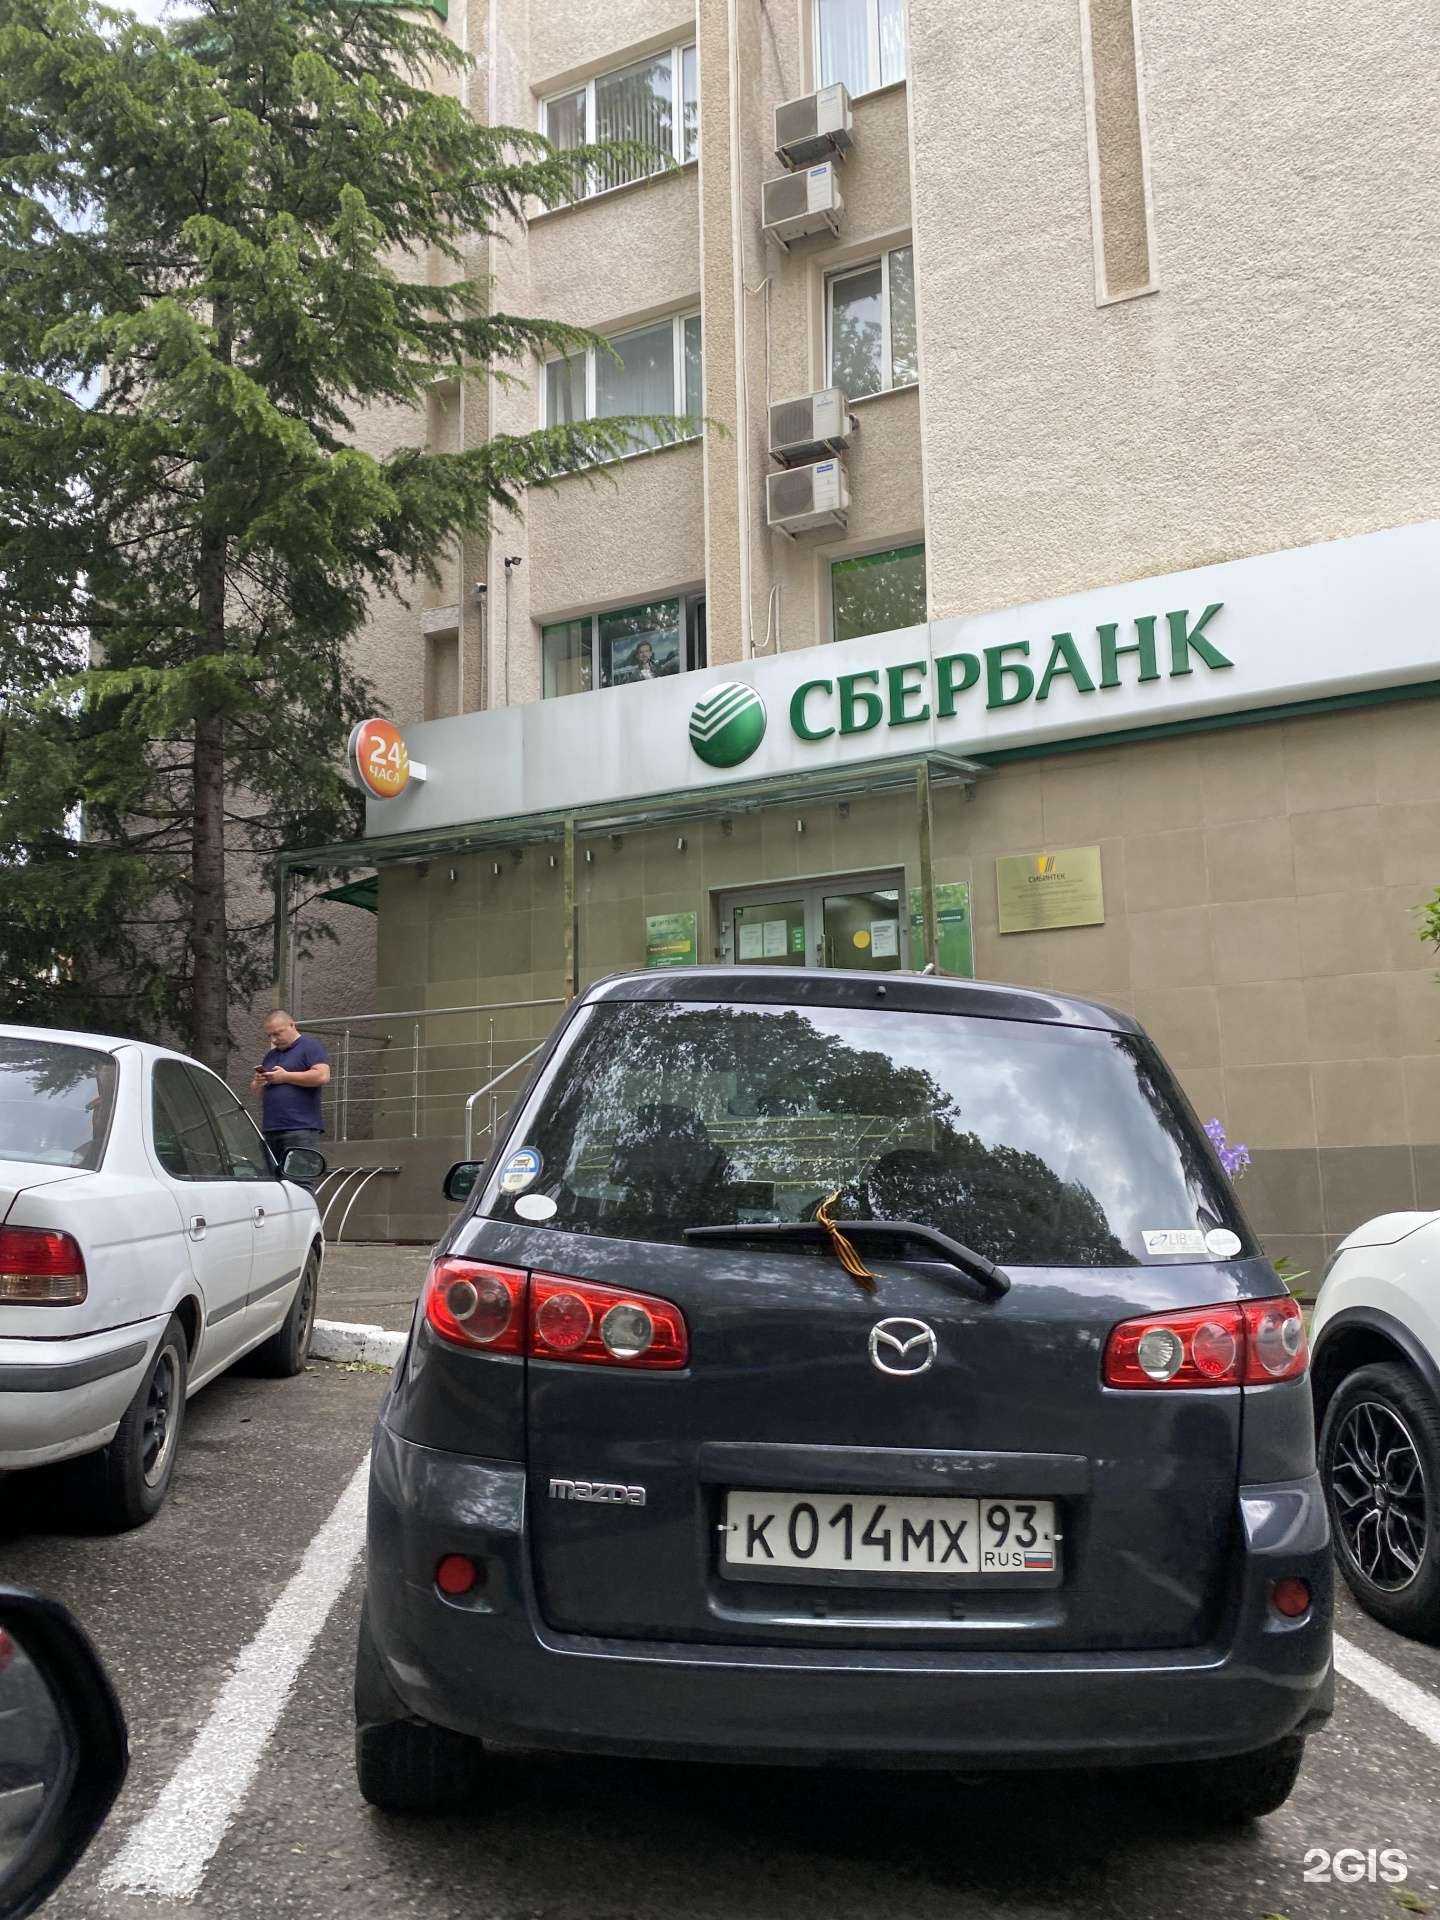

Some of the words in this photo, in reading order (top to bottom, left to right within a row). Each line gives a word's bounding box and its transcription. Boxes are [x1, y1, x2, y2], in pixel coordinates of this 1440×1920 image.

[789, 602, 1235, 741] СБЕРБАНК
[370, 735, 402, 769] 24
[369, 764, 401, 784] ЧАСА
[986, 1504, 1038, 1548] 93
[984, 1551, 1023, 1567] RUS
